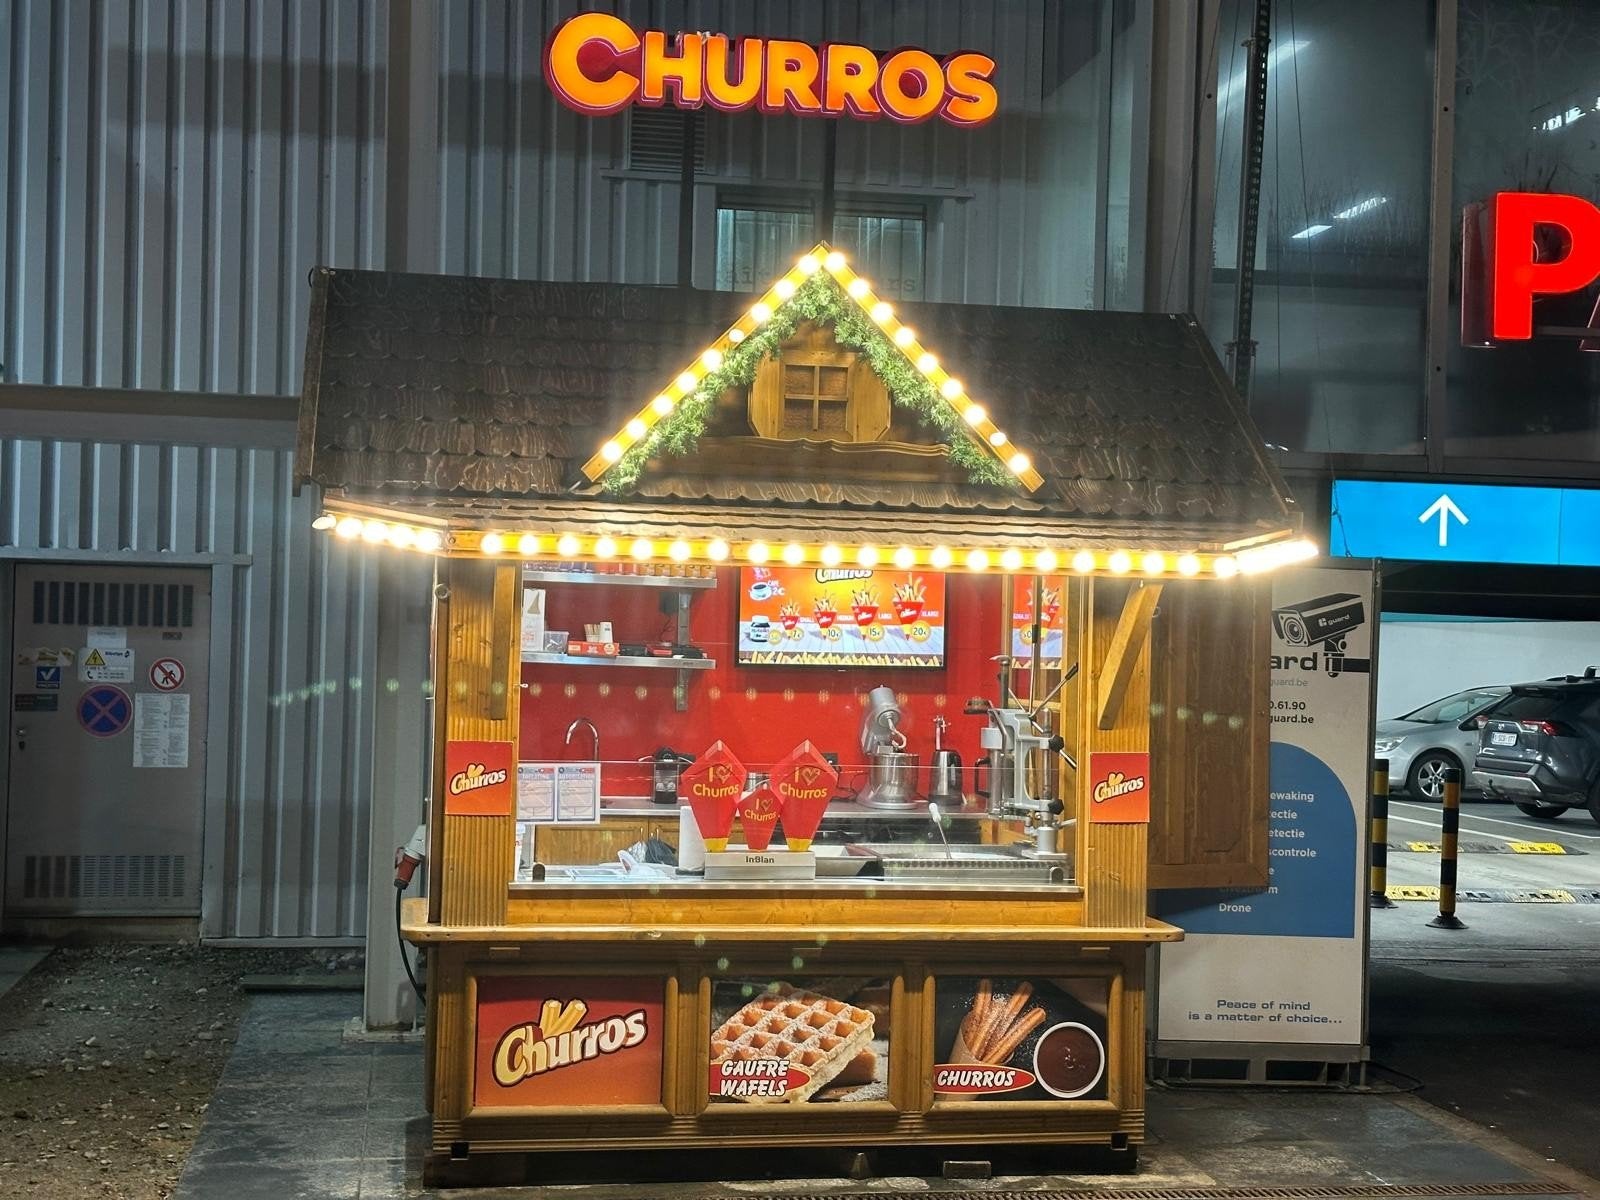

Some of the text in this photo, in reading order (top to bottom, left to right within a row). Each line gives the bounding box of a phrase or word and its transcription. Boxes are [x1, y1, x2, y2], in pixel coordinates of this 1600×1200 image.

[546, 12, 998, 126] CHURROS
[450, 768, 508, 796] Churros
[692, 783, 740, 798] Churros
[779, 782, 828, 800] Churros
[1093, 775, 1145, 803] Churros
[744, 809, 778, 822] Churros
[1219, 903, 1252, 913] Drone
[1217, 1000, 1311, 1011] Peace of mind
[1188, 1011, 1200, 1020] is
[1204, 1013, 1213, 1021] a
[1216, 1012, 1264, 1022] matter
[1268, 1012, 1281, 1022] of
[493, 1009, 648, 1087] Churros
[721, 1059, 790, 1078] GAUFRE
[937, 1069, 1016, 1088] CHURROS
[720, 1079, 788, 1097] WAFELS
